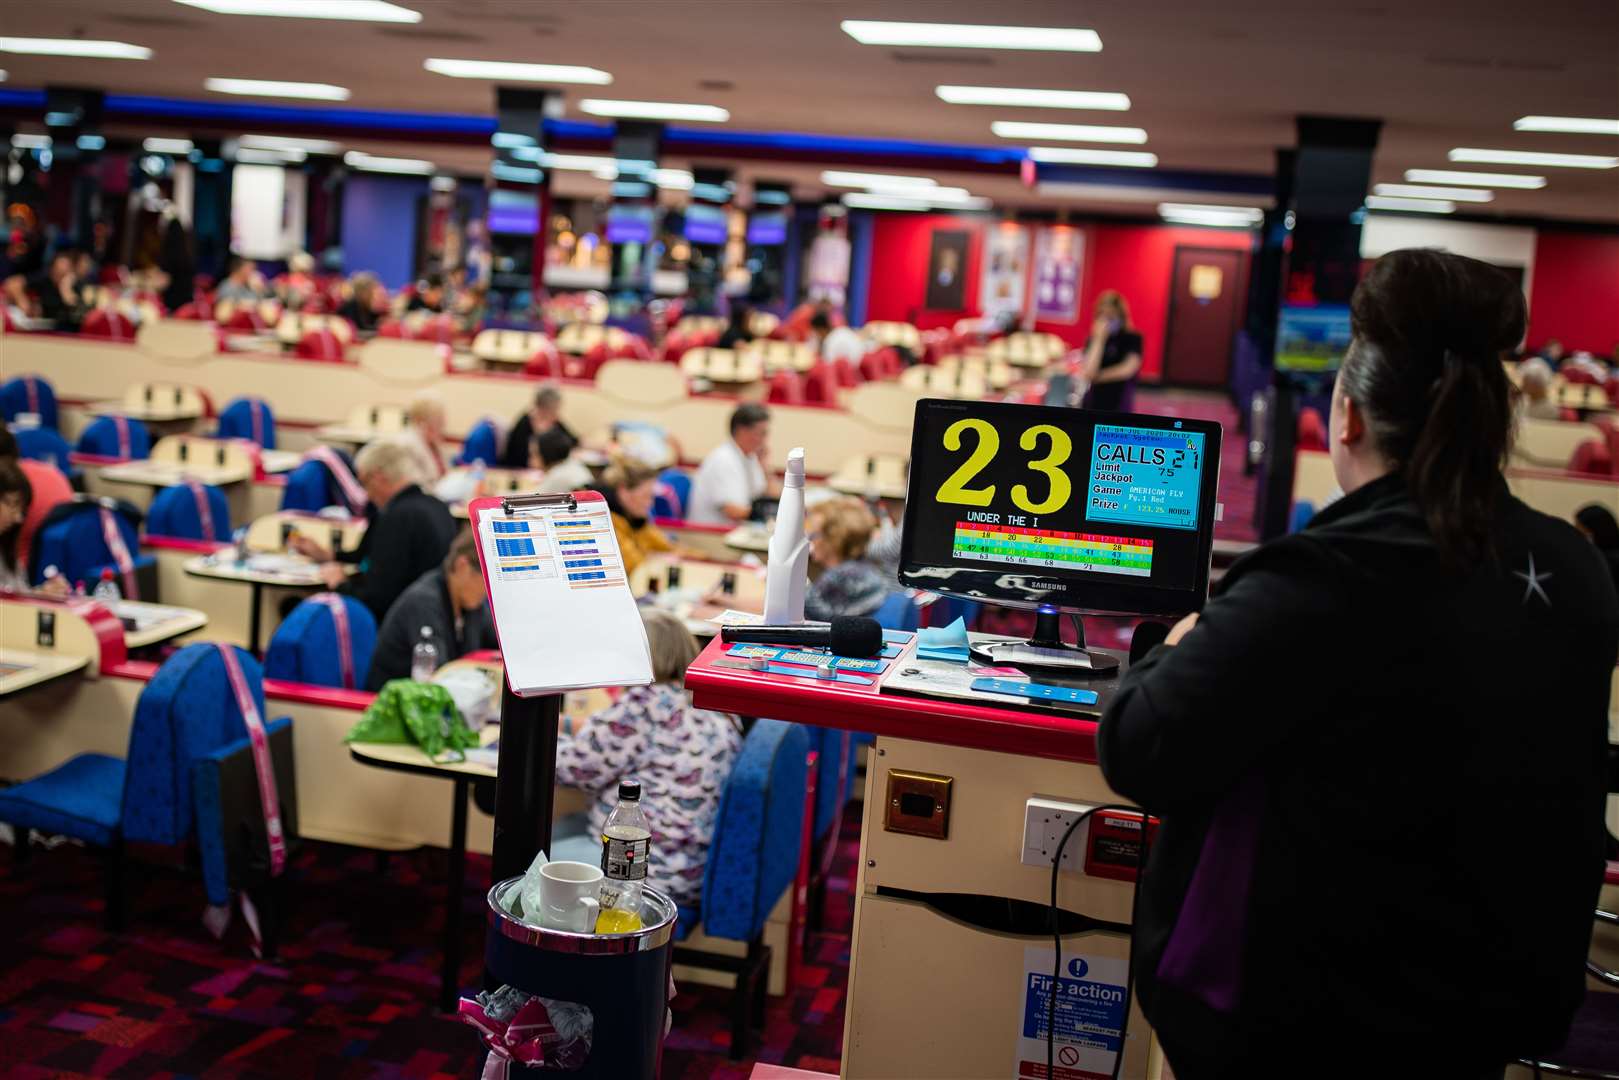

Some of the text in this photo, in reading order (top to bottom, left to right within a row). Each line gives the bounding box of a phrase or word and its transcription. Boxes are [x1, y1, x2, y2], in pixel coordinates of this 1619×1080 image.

[1097, 443, 1166, 466] CALLS
[1172, 449, 1199, 471] 21
[936, 418, 1073, 515] 23
[1095, 461, 1176, 477] Limit 75
[1094, 471, 1133, 484] Jackpot
[1092, 484, 1185, 498] Game AMERICAN FLY
[1091, 497, 1119, 510] Prize
[1168, 506, 1192, 516] HOUSE
[967, 511, 1038, 528] UNDER THE I
[1008, 533, 1017, 541] 20
[1112, 543, 1122, 551] 28
[979, 552, 989, 560] 63
[1044, 558, 1053, 566] 68
[1031, 581, 1067, 592] SAMSUNG
[1068, 983, 1122, 1002] action
